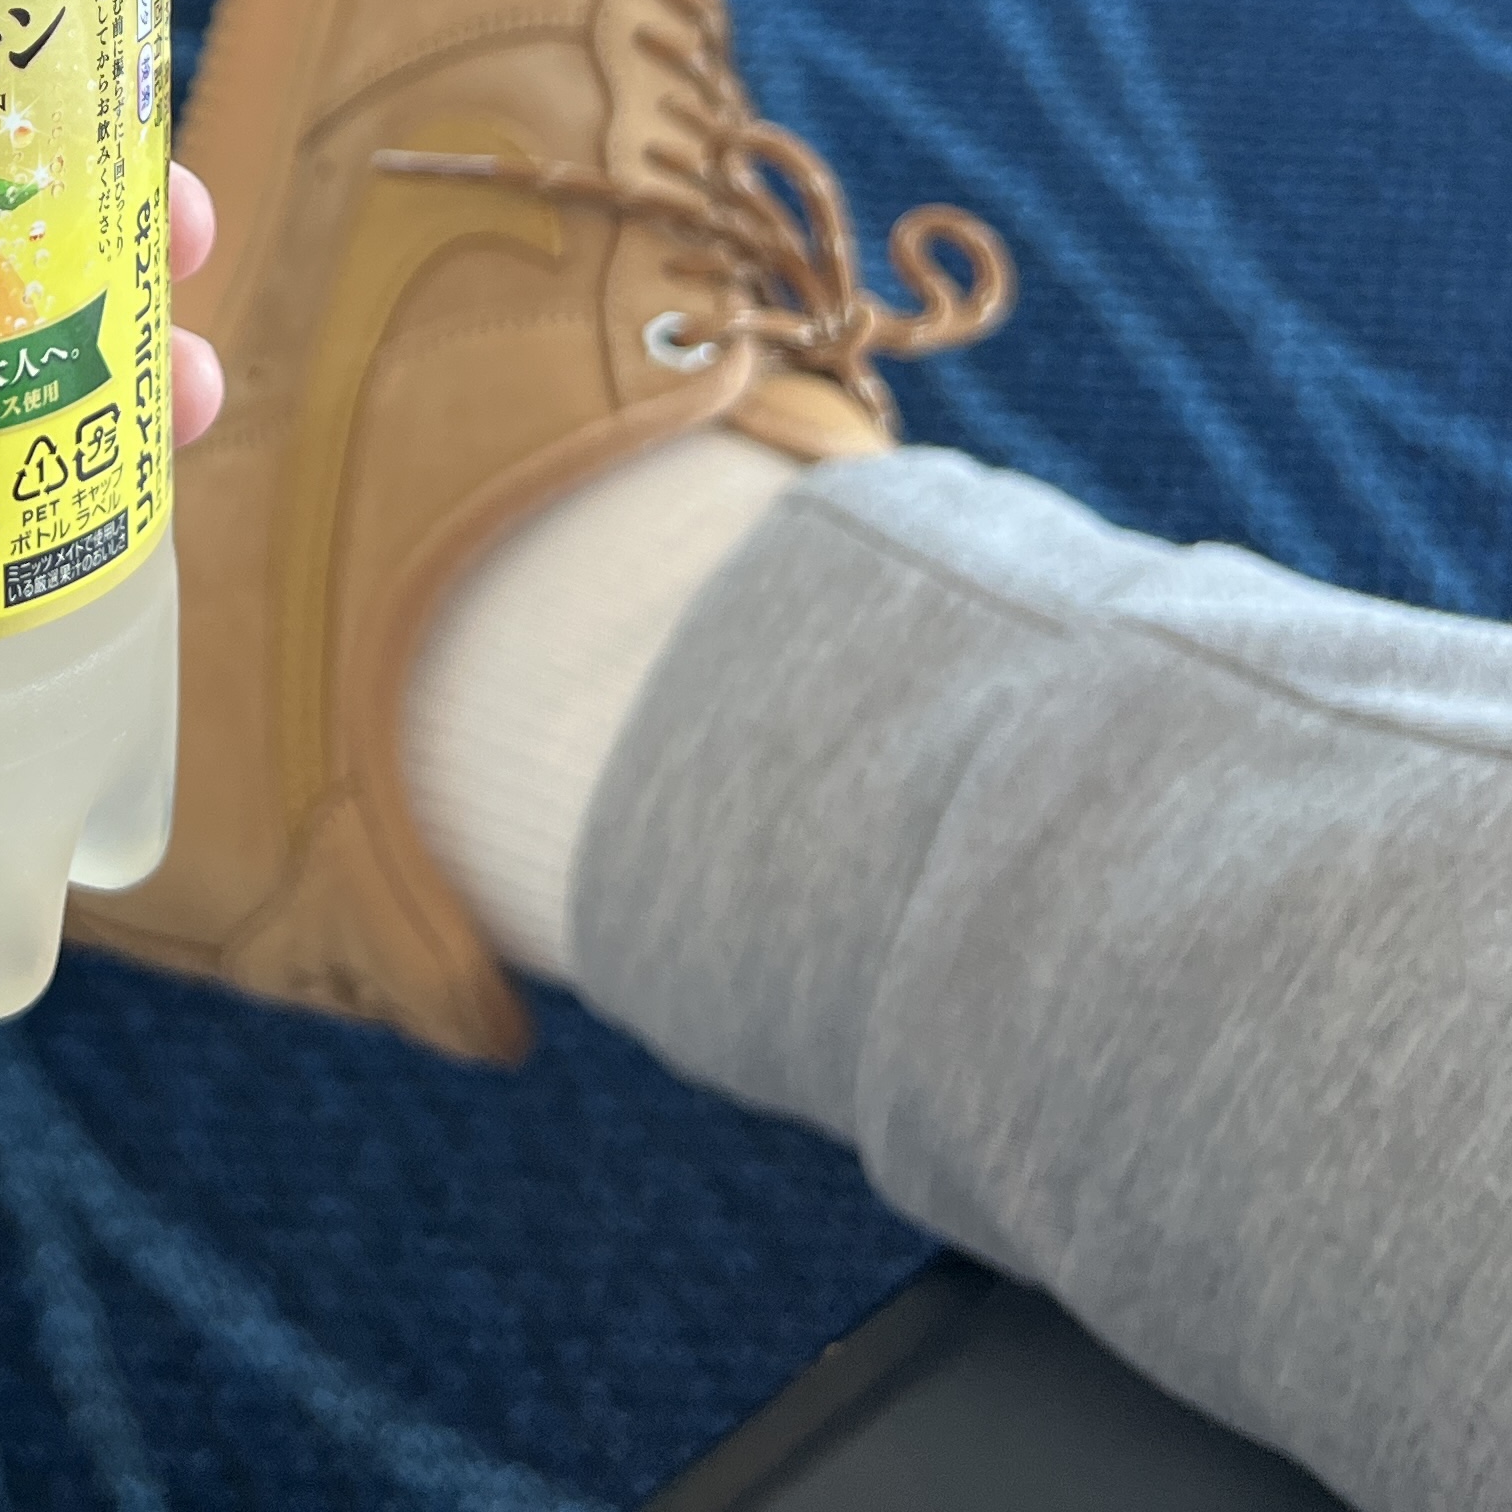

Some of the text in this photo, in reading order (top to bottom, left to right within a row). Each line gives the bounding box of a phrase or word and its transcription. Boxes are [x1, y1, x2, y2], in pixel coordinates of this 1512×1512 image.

[21, 498, 61, 527] PET
[75, 491, 122, 531] ラベル
[10, 519, 71, 556] ボトル
